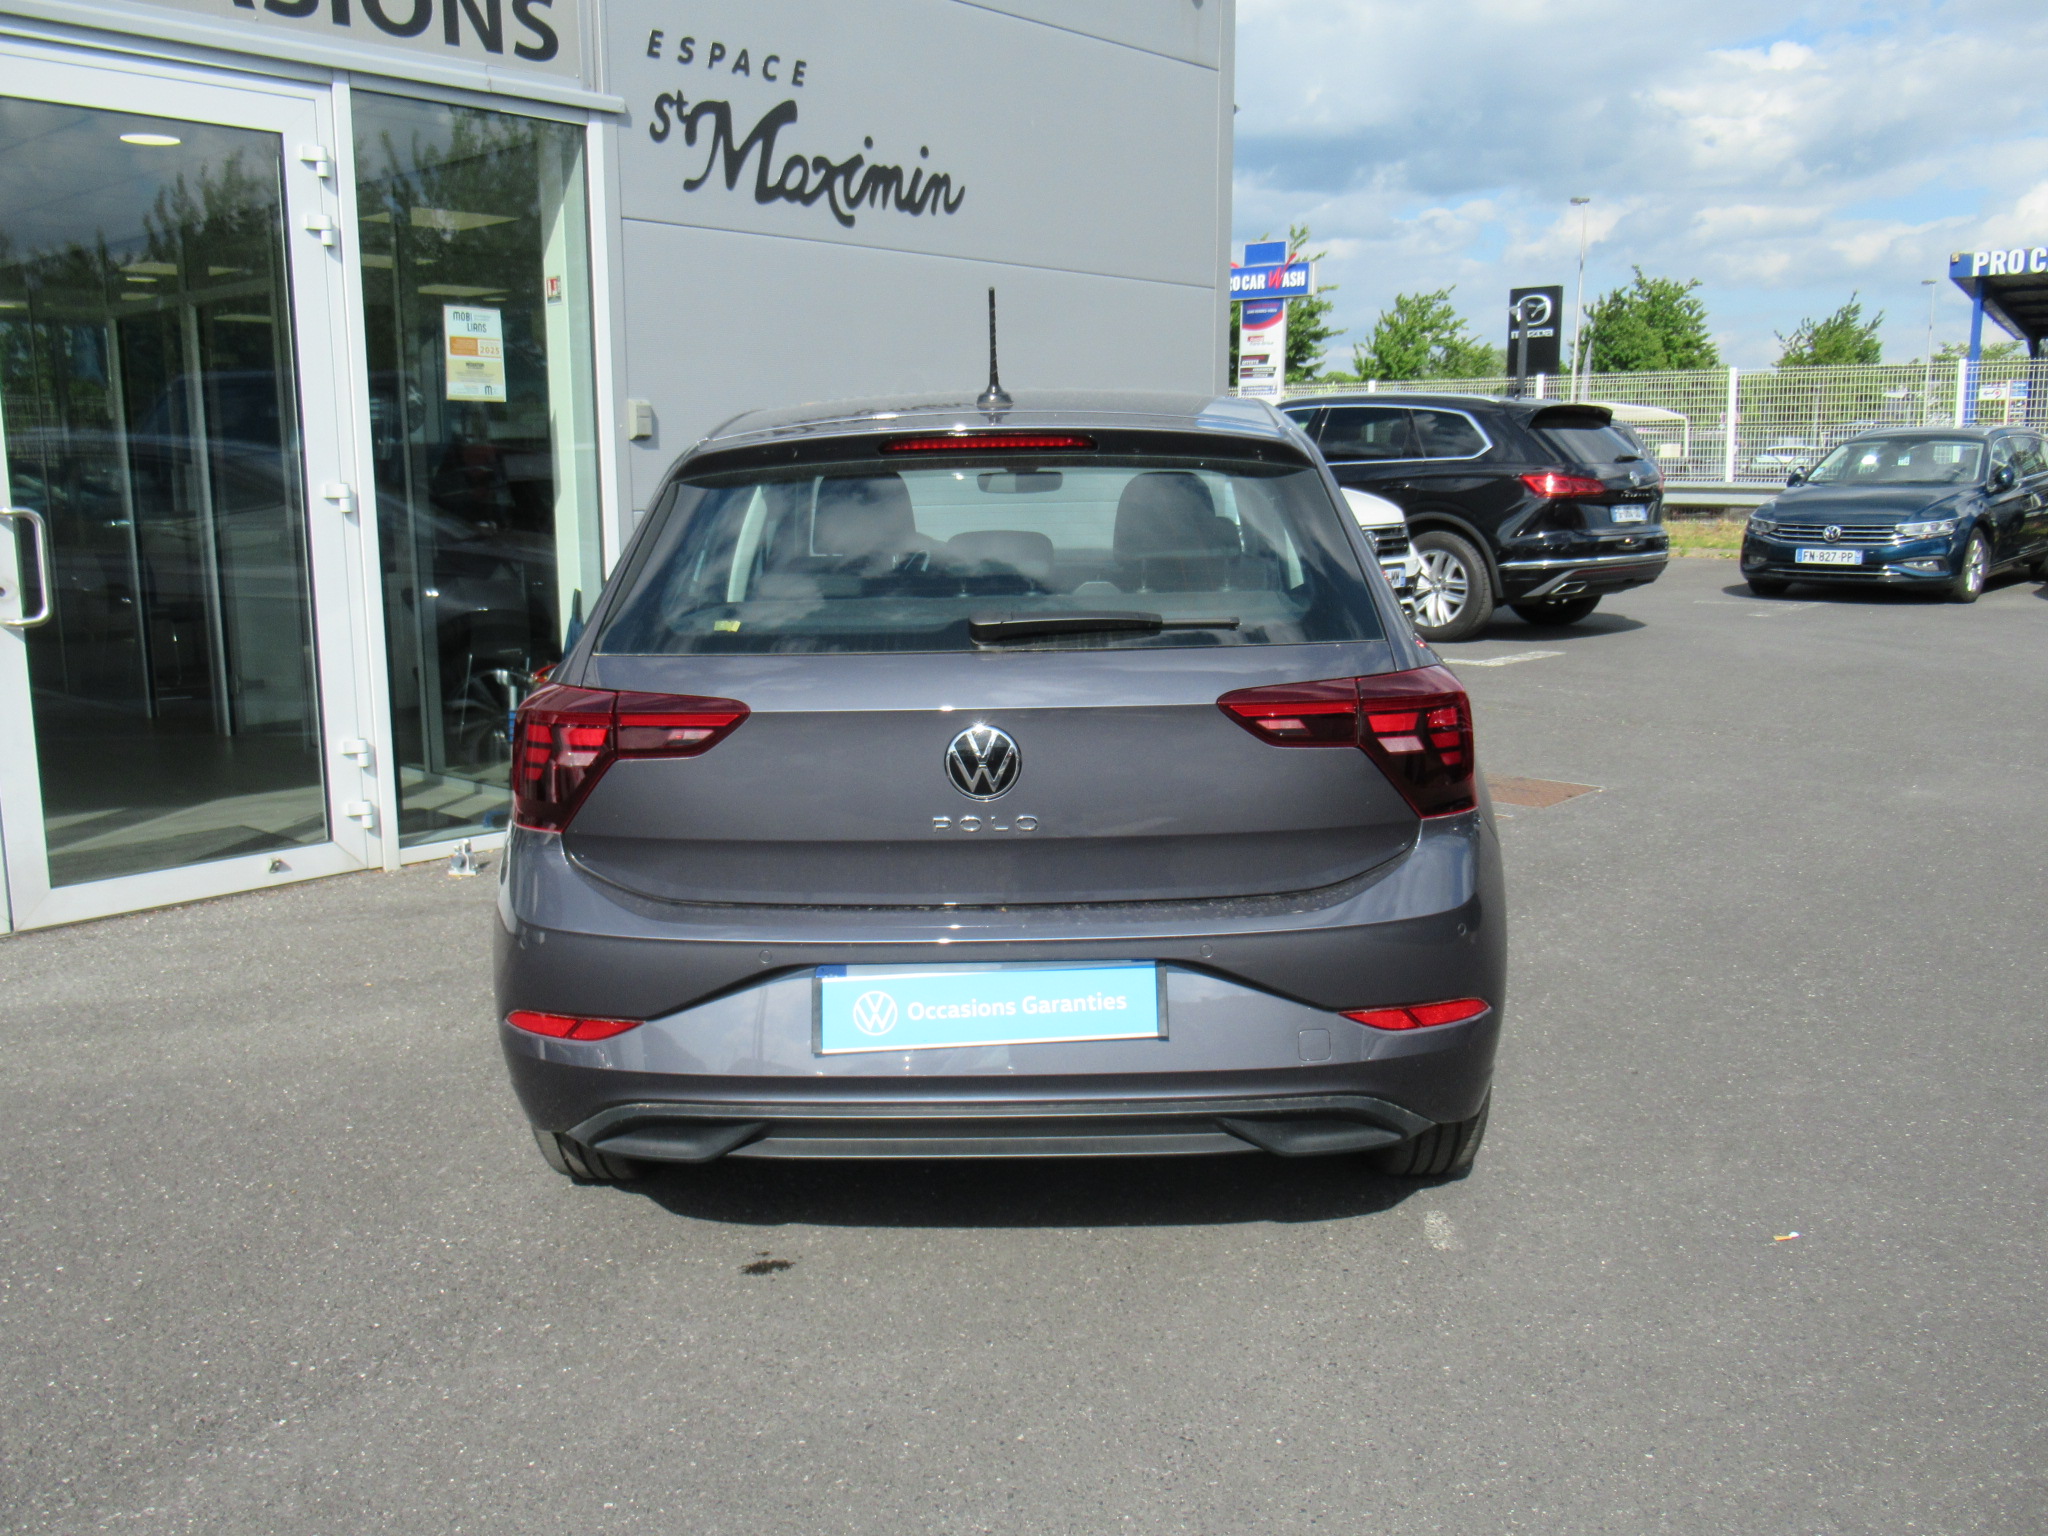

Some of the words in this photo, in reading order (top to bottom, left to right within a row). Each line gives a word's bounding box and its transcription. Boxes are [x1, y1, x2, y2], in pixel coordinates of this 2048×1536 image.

[646, 29, 808, 88] ESPACE
[683, 99, 966, 229] Maximin
[1241, 273, 1266, 291] CAR
[1268, 252, 1306, 290] WASH
[1971, 248, 2025, 277] PRO
[2029, 246, 2048, 274] C
[1511, 329, 1553, 340] mzda
[932, 815, 1039, 833] POLO
[907, 997, 1016, 1022] Occasions
[1022, 991, 1128, 1016] Garanties
